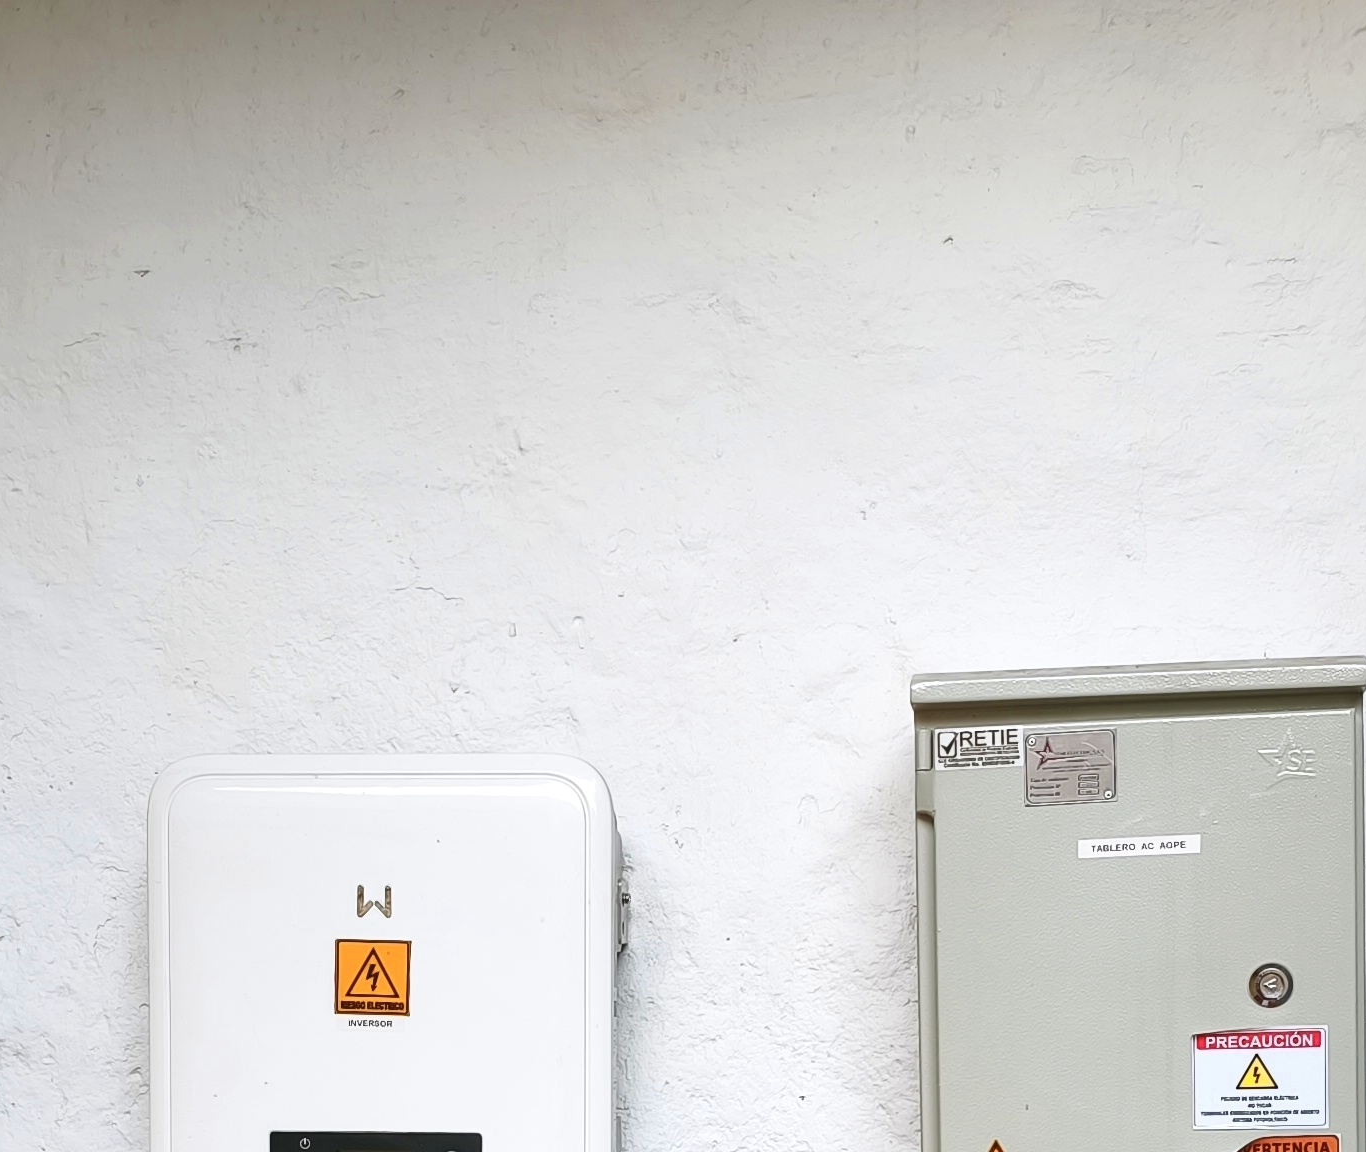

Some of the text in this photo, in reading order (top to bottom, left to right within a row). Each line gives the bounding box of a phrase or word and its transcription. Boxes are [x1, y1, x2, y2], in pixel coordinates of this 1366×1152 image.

[960, 729, 1019, 747] RETIE
[1091, 843, 1136, 852] TABLERO
[348, 1019, 393, 1027] INVERSOR
[1205, 1032, 1313, 1048] PRECAUCIÓN
